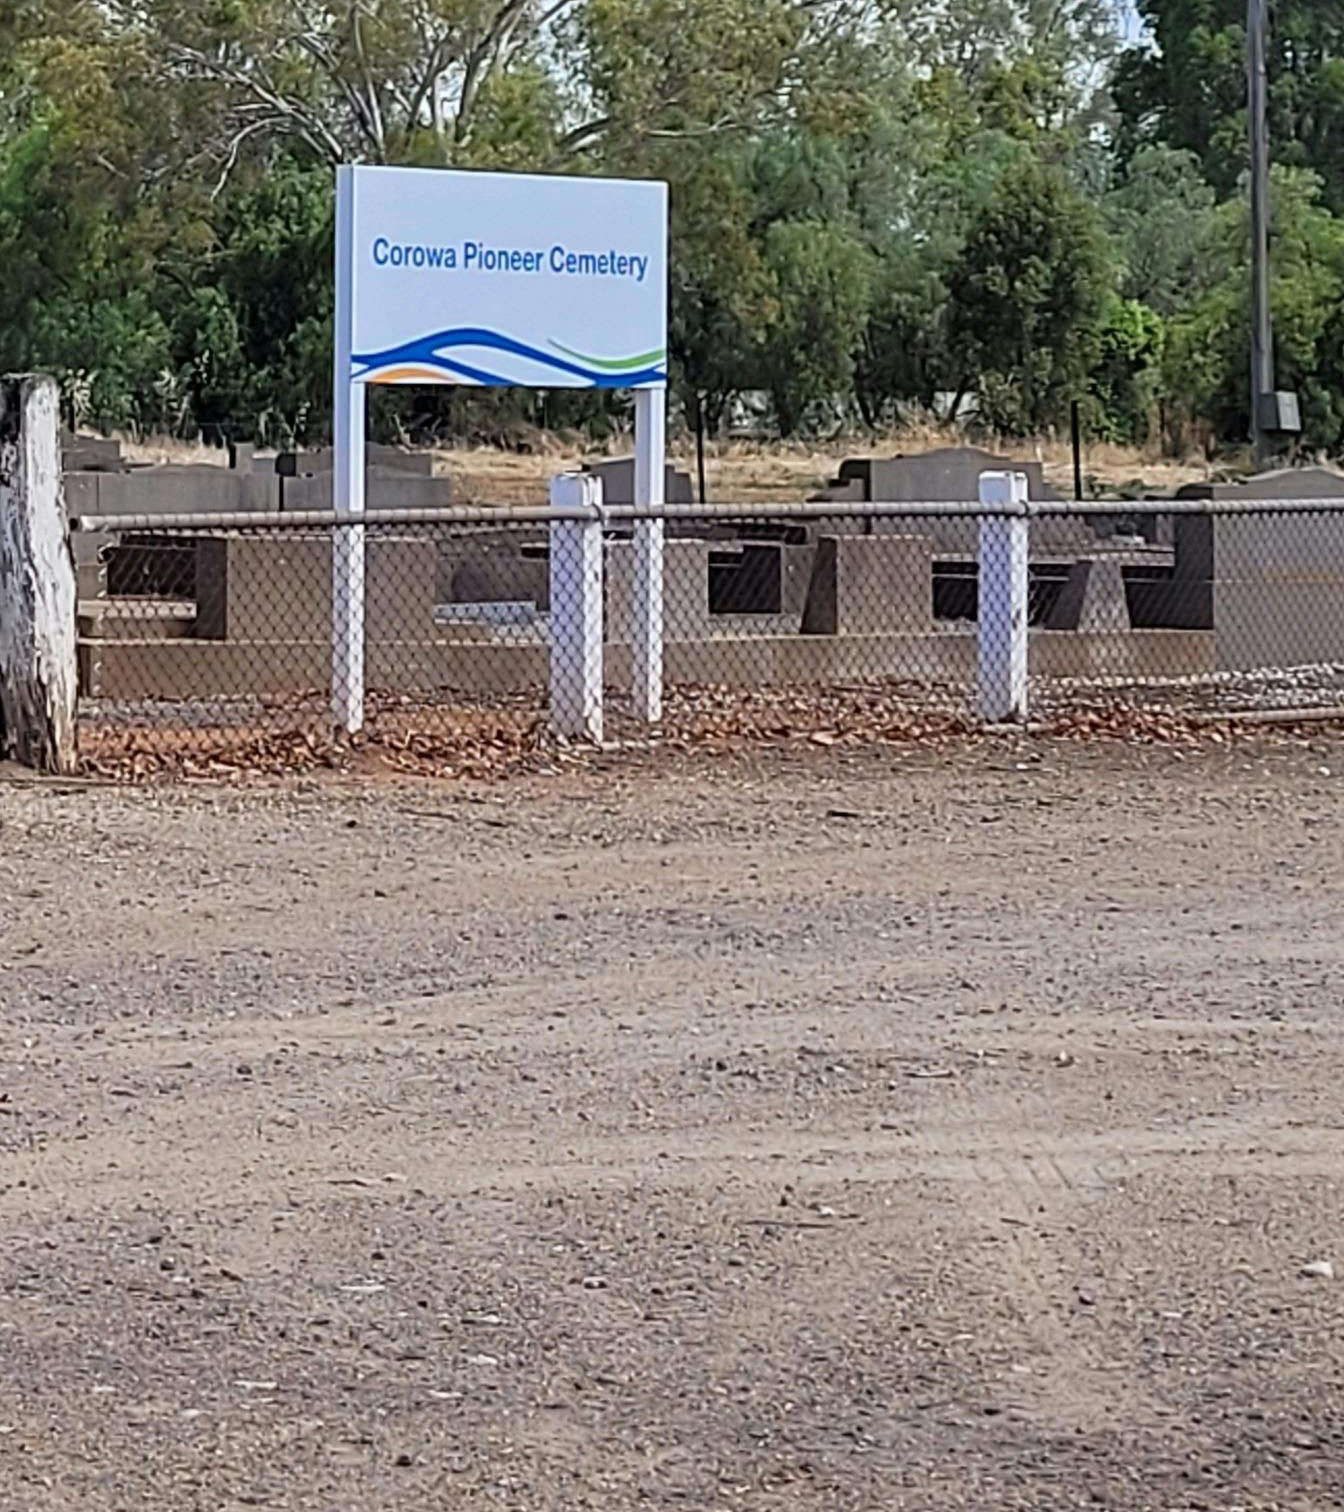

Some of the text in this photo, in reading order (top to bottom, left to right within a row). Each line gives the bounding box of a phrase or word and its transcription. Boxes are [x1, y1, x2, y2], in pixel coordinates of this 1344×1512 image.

[373, 237, 649, 282] Corowa Pioneer Cemetery
